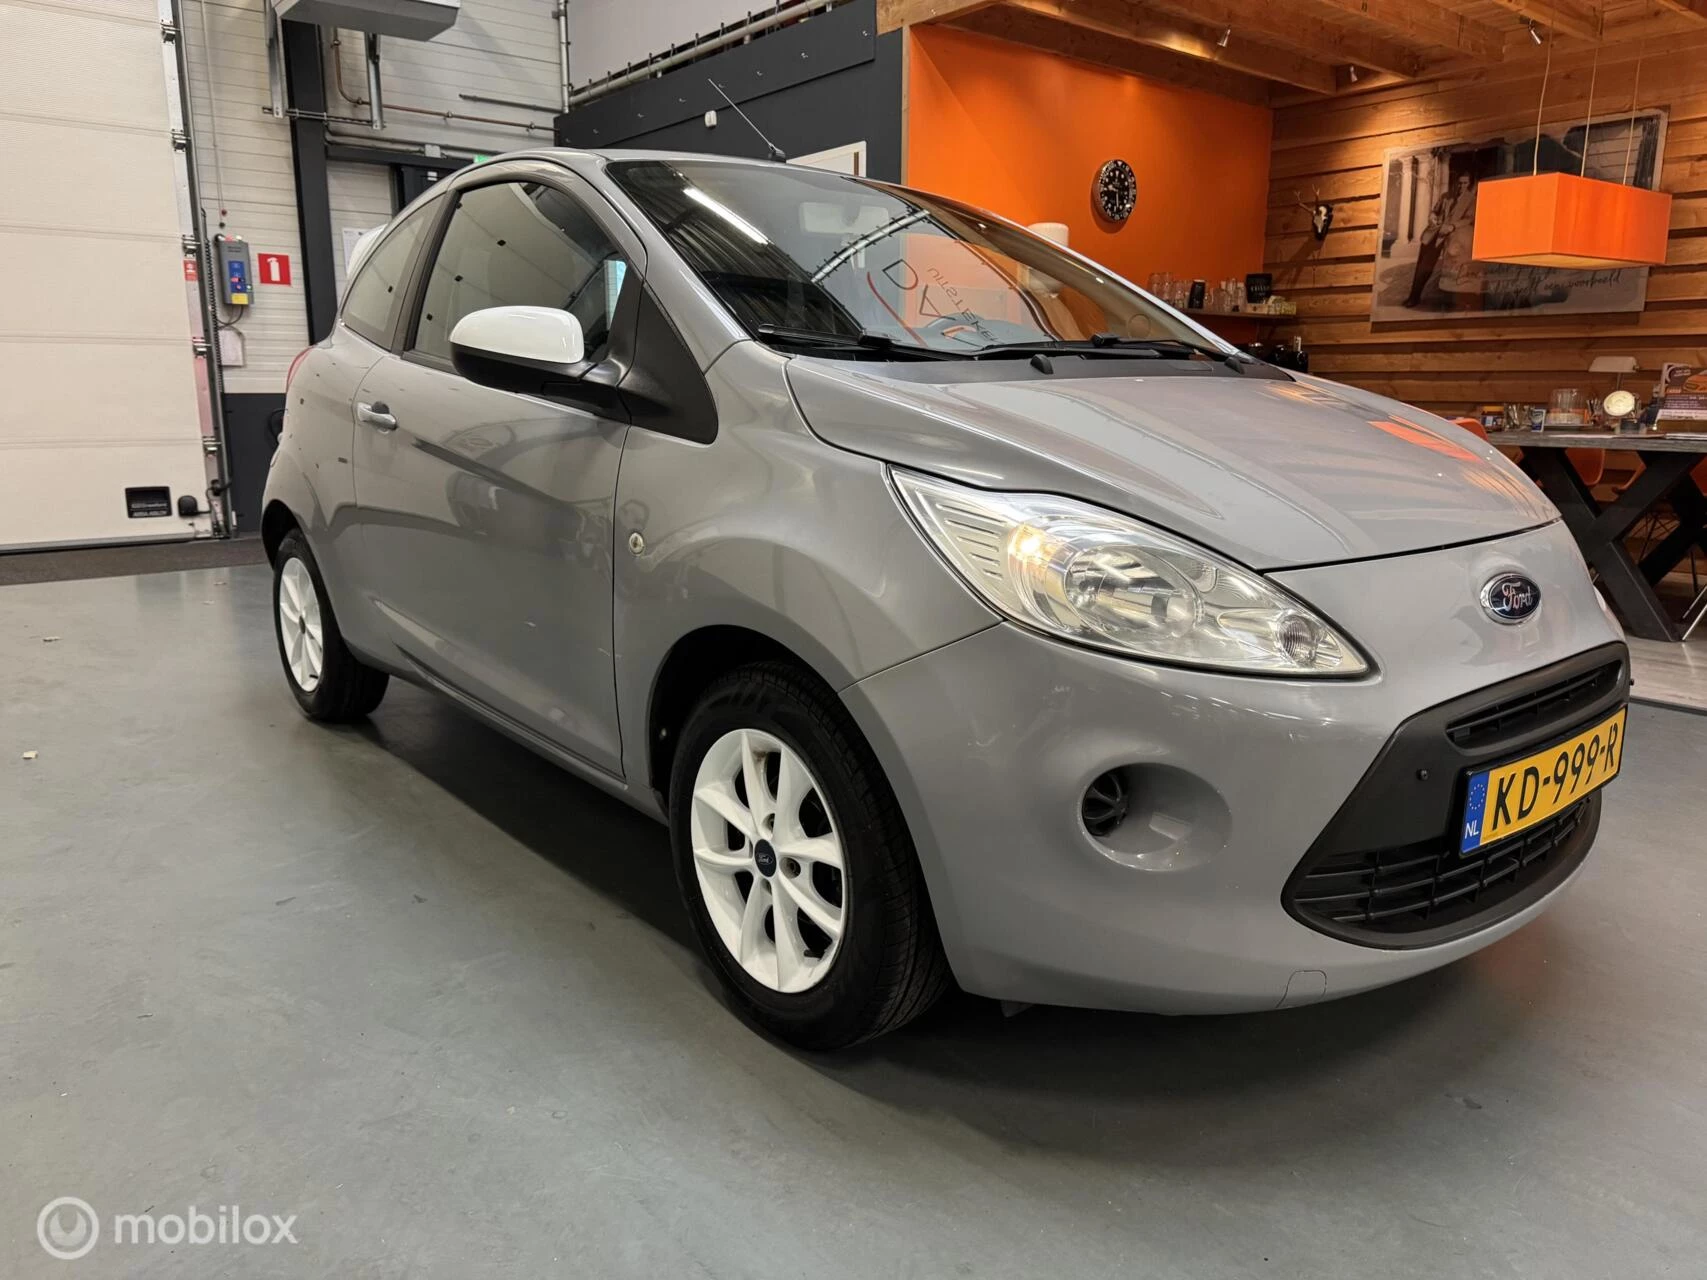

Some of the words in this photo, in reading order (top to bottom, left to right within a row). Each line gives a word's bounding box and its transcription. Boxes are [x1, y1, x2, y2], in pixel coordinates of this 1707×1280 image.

[1502, 582, 1533, 610] Ford
[1492, 722, 1619, 832] KD-999-R
[1464, 820, 1479, 839] NL
